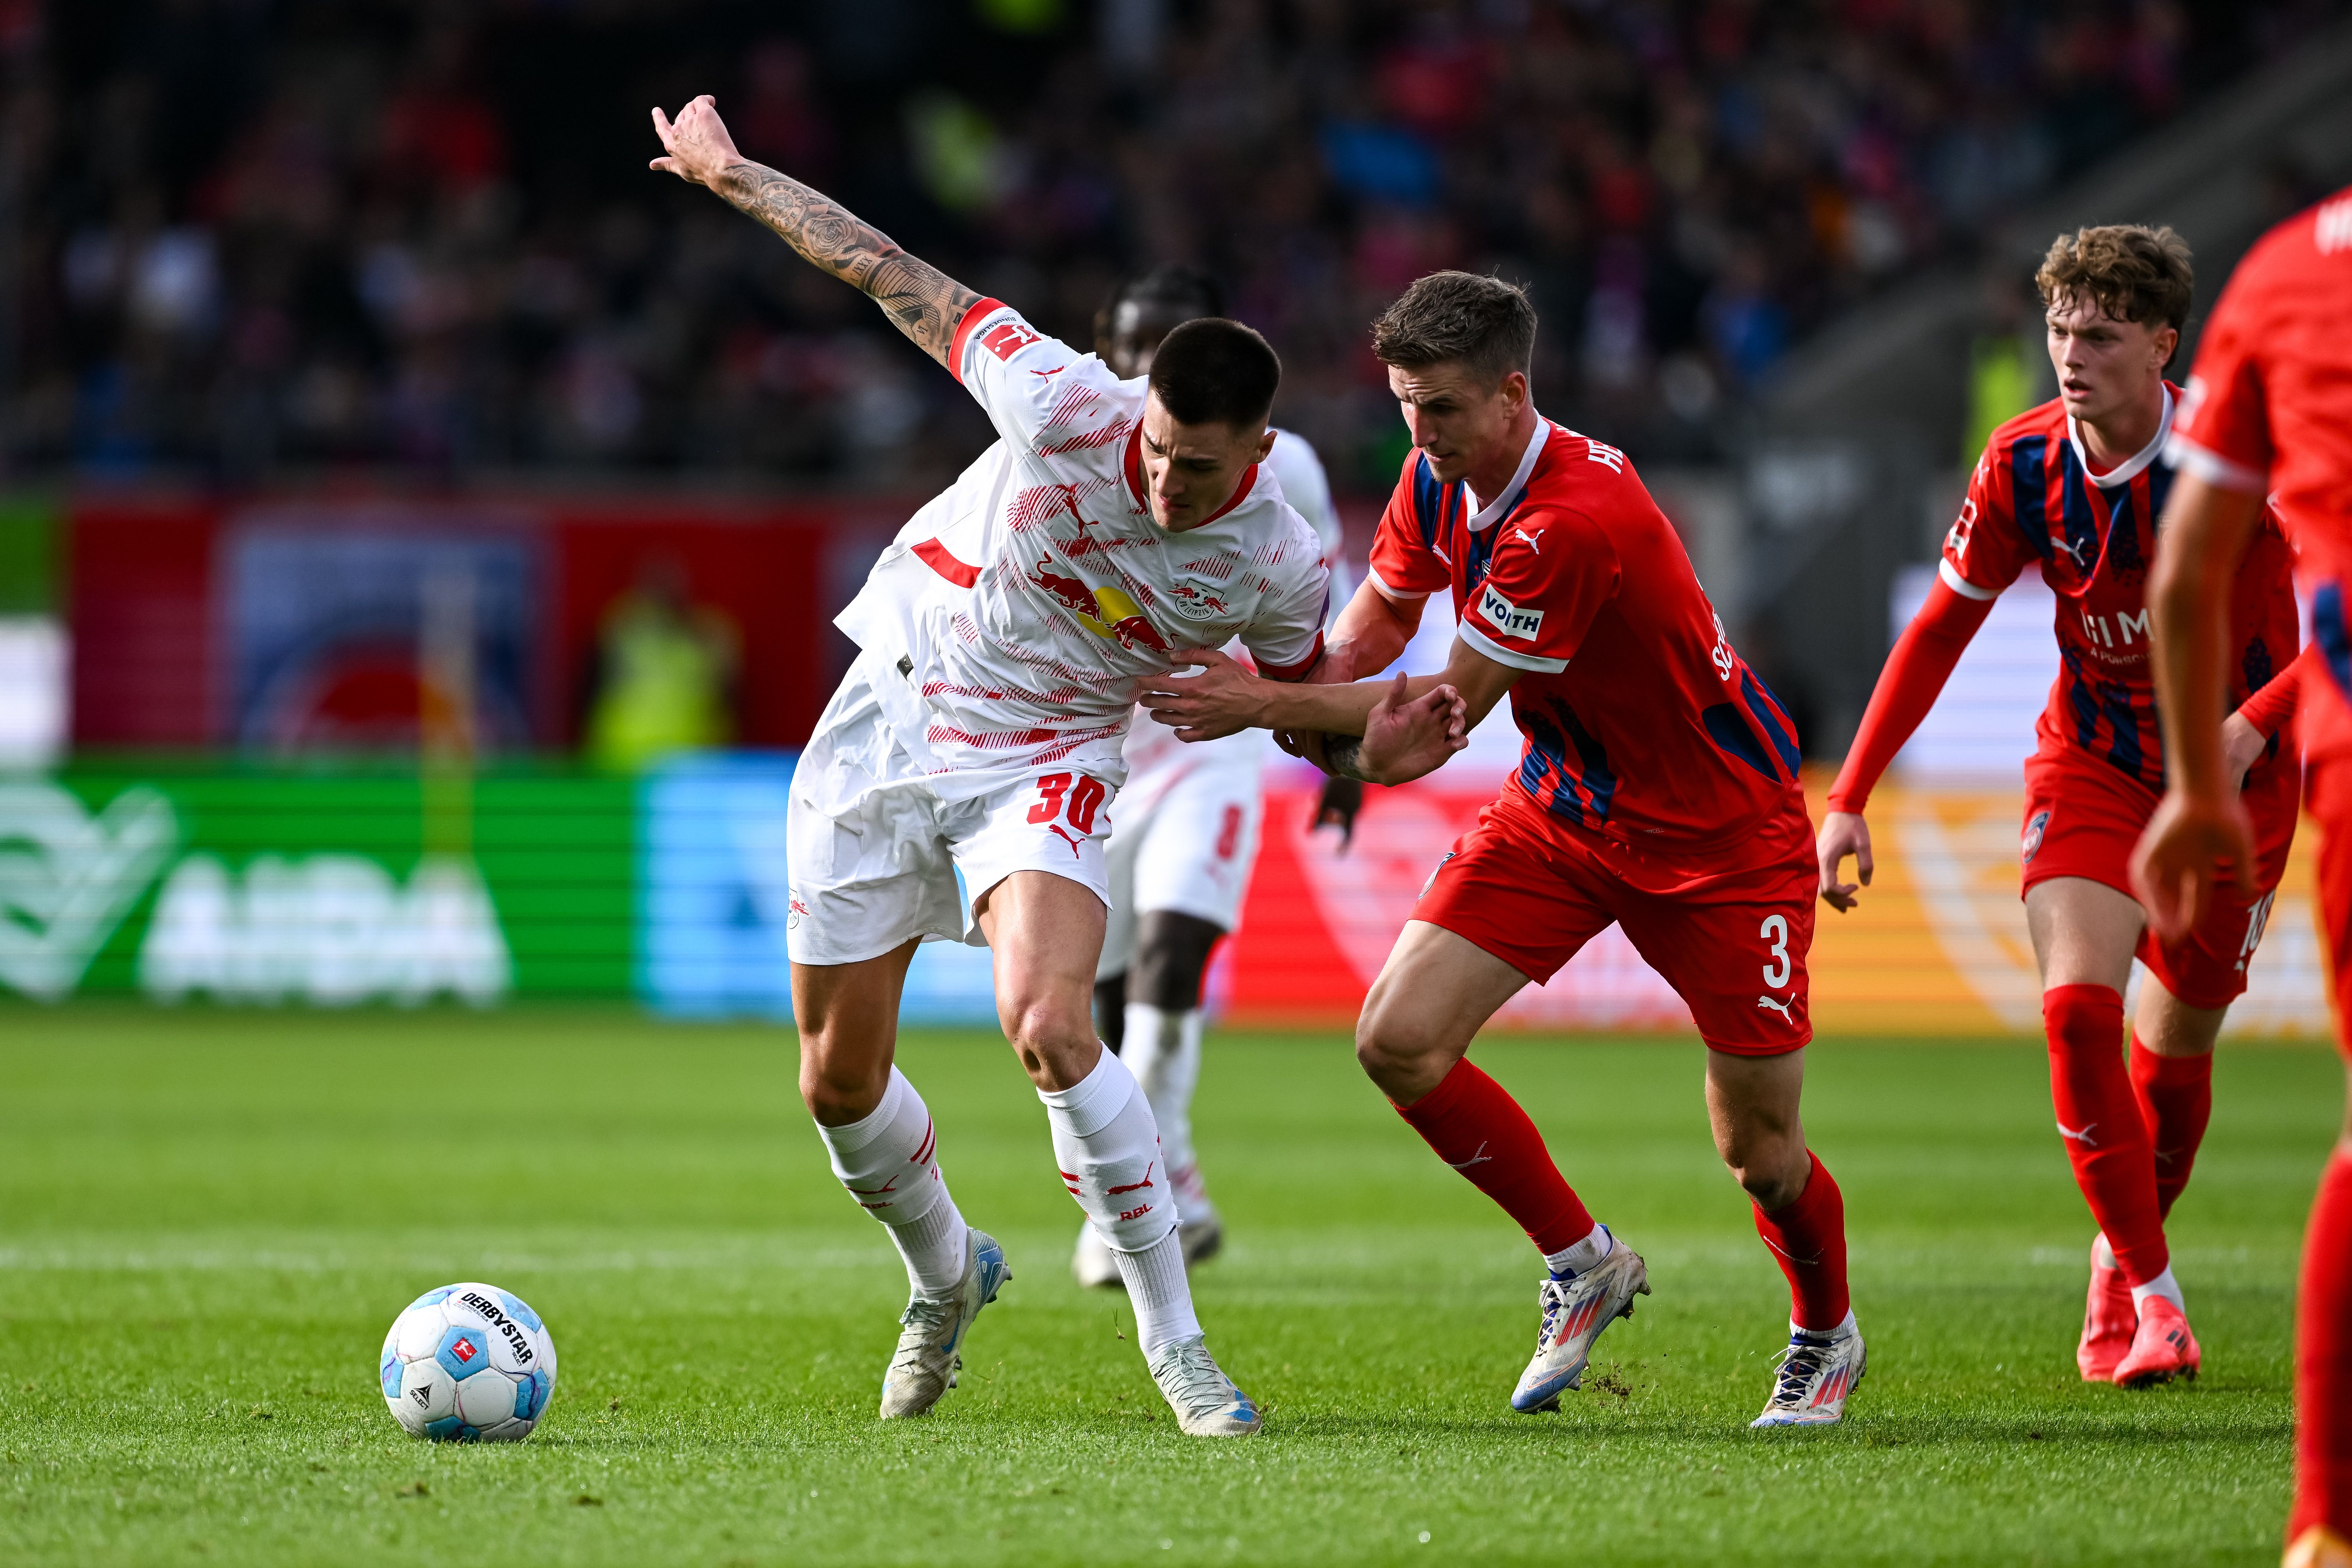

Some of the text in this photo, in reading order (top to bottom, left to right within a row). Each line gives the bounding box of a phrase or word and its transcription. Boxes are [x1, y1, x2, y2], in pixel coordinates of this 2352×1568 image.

[976, 317, 1017, 339] BUNDESLIGA
[1184, 608, 1209, 616] LEIPZIG
[1486, 591, 1540, 632] VOITH
[1026, 772, 1105, 835] 30
[1760, 914, 1791, 988] 3
[1120, 1203, 1153, 1221] RBL
[461, 1302, 489, 1322] BUNDESLIGA
[460, 1292, 533, 1364] DERBYSTAR
[512, 1351, 522, 1367] SELECT
[409, 1389, 429, 1410] SELECT
